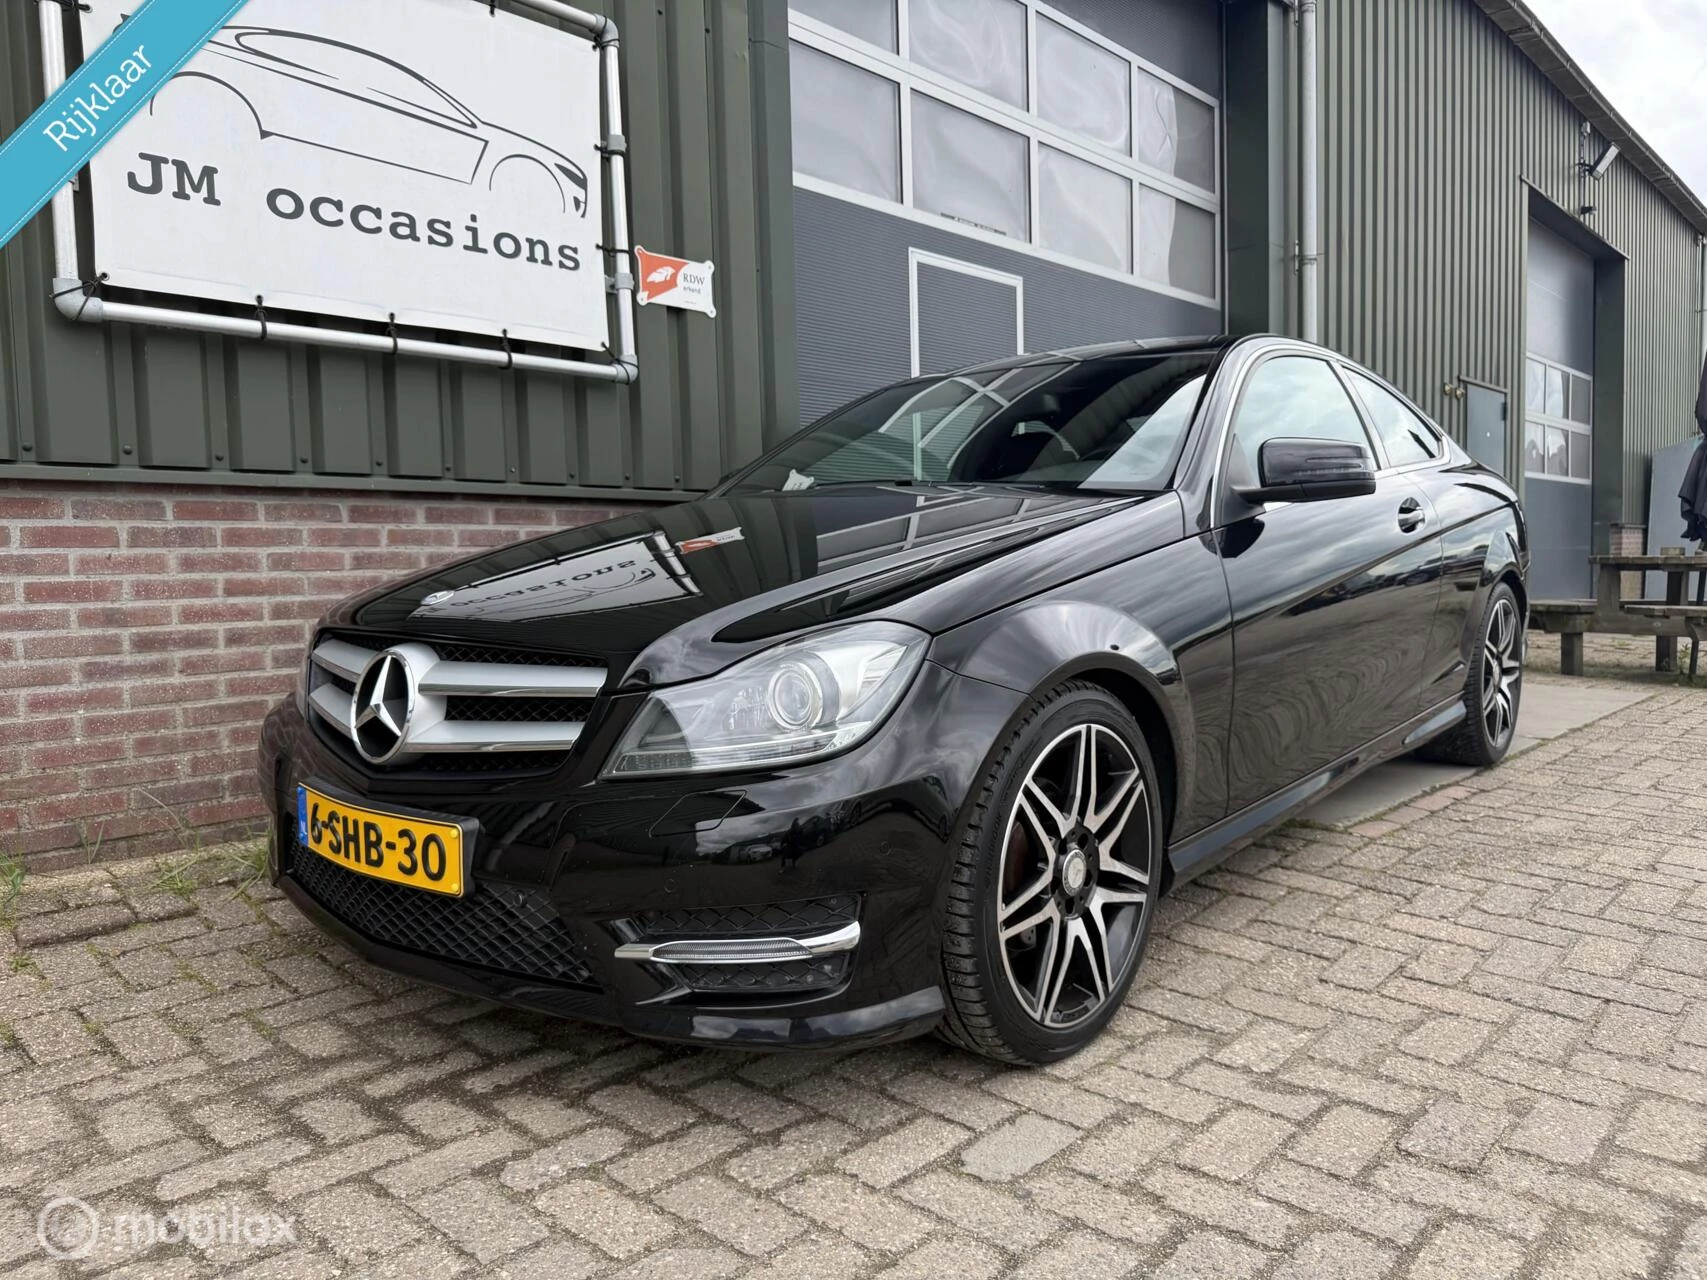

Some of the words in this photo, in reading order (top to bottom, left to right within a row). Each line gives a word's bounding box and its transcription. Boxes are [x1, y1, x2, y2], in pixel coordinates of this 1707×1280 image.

[127, 152, 221, 206] JM
[266, 188, 580, 271] occasions
[682, 273, 705, 286] RDW
[310, 802, 446, 881] 6-SHB-30
